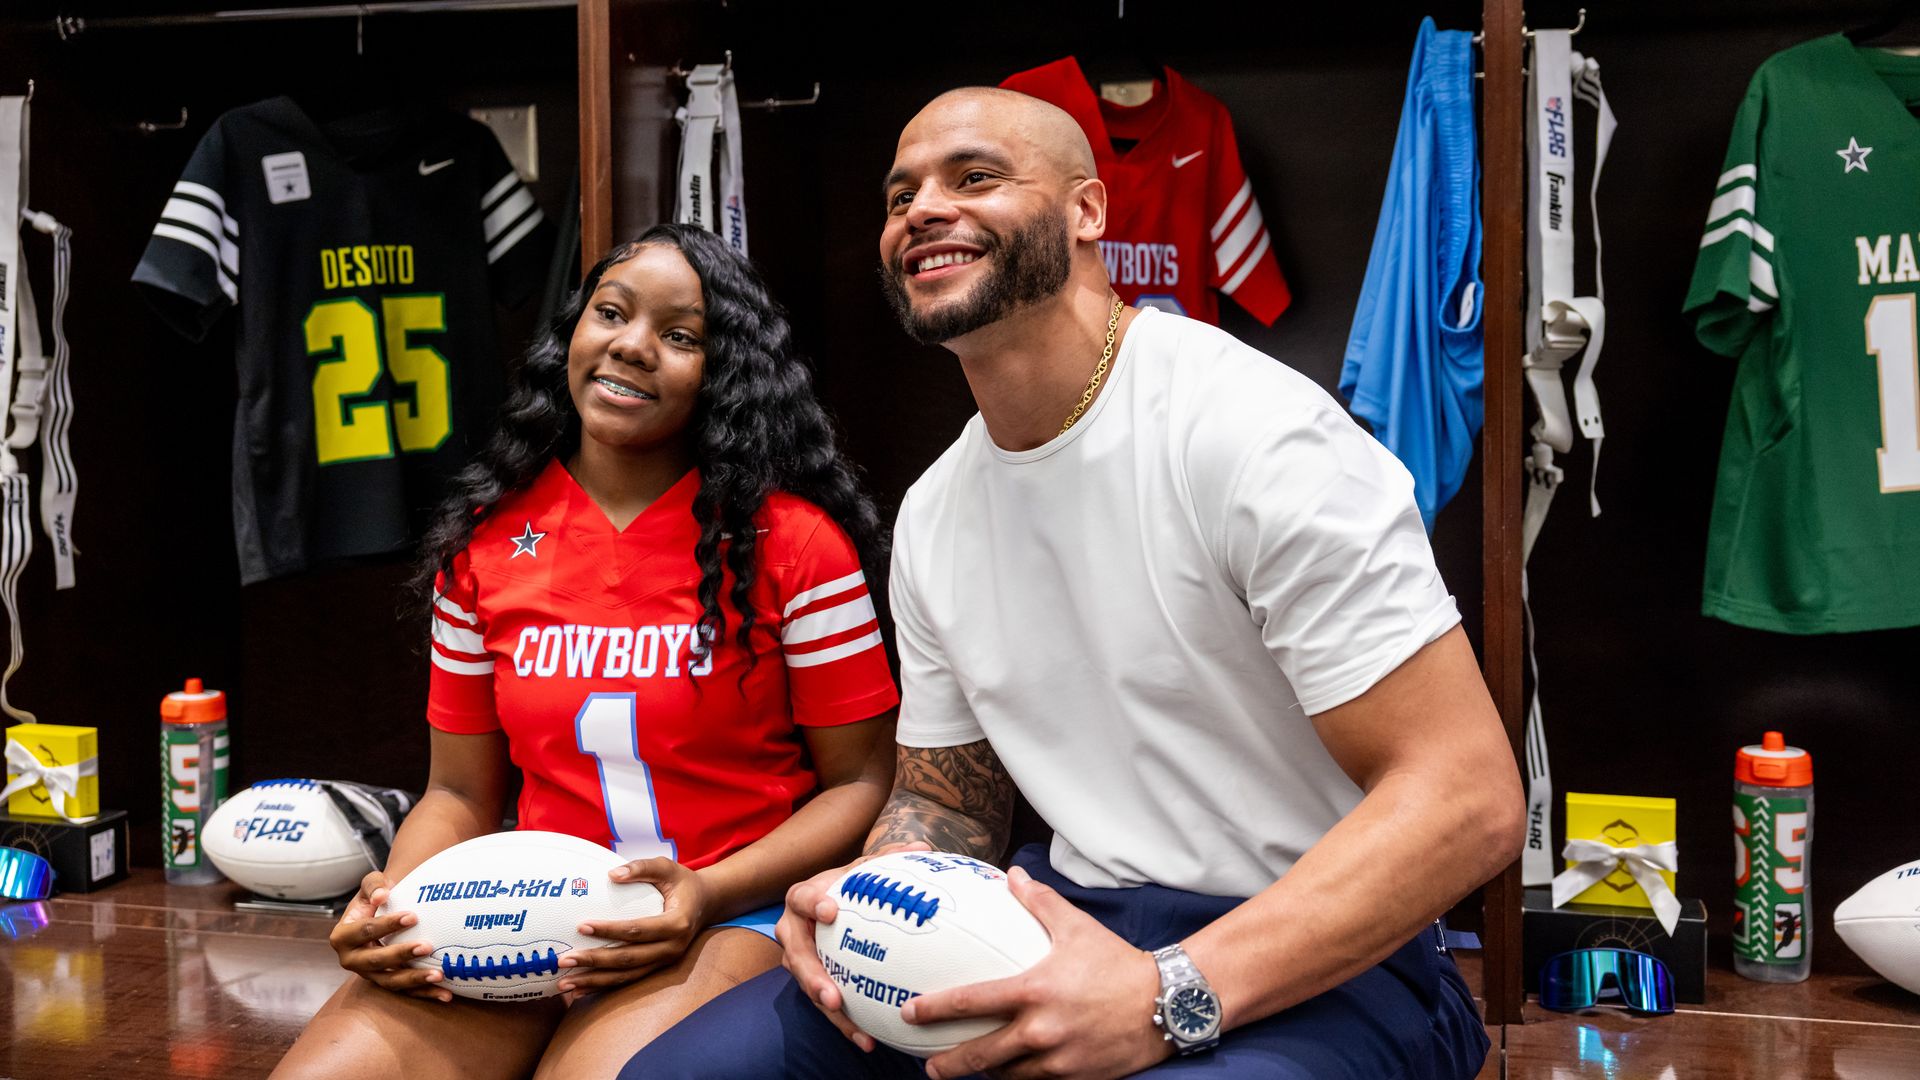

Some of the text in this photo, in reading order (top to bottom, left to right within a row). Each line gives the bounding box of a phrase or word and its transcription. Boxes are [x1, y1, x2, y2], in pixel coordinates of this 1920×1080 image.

[1545, 107, 1566, 158] FLAG
[320, 245, 415, 289] DESOTO
[1097, 240, 1179, 286] WBOYS
[1855, 232, 1920, 285] MA
[302, 292, 453, 466] 25
[1864, 292, 1920, 494] 1
[513, 623, 716, 679] COWBOYS
[574, 691, 678, 864] 1
[242, 817, 310, 843] FLAG
[1529, 810, 1543, 851] FLAG
[416, 877, 567, 904] PLAY FOOTBALL
